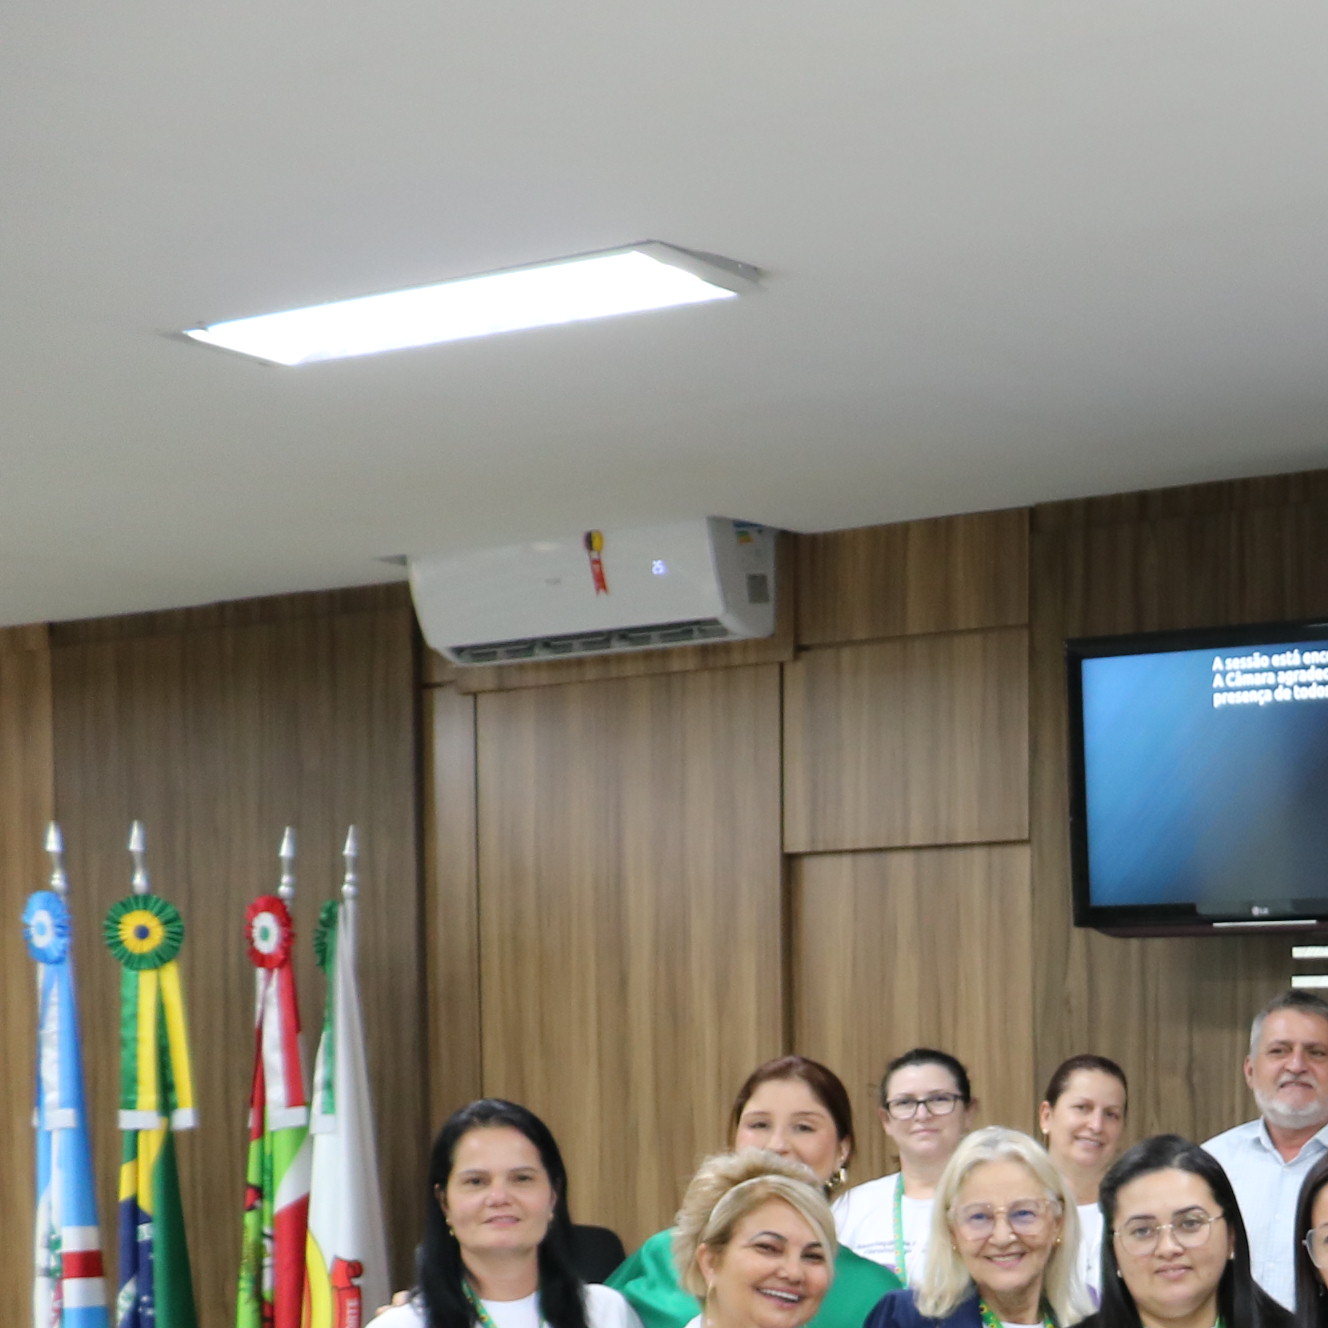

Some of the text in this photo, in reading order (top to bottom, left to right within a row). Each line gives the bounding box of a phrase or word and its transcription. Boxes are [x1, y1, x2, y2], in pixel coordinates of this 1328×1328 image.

[1212, 656, 1224, 671] A
[1225, 651, 1270, 671] sessão
[1271, 648, 1300, 667] está
[1212, 673, 1225, 688] A
[1225, 670, 1276, 687] Câmara
[1212, 689, 1273, 709] presença
[1273, 684, 1292, 701] de
